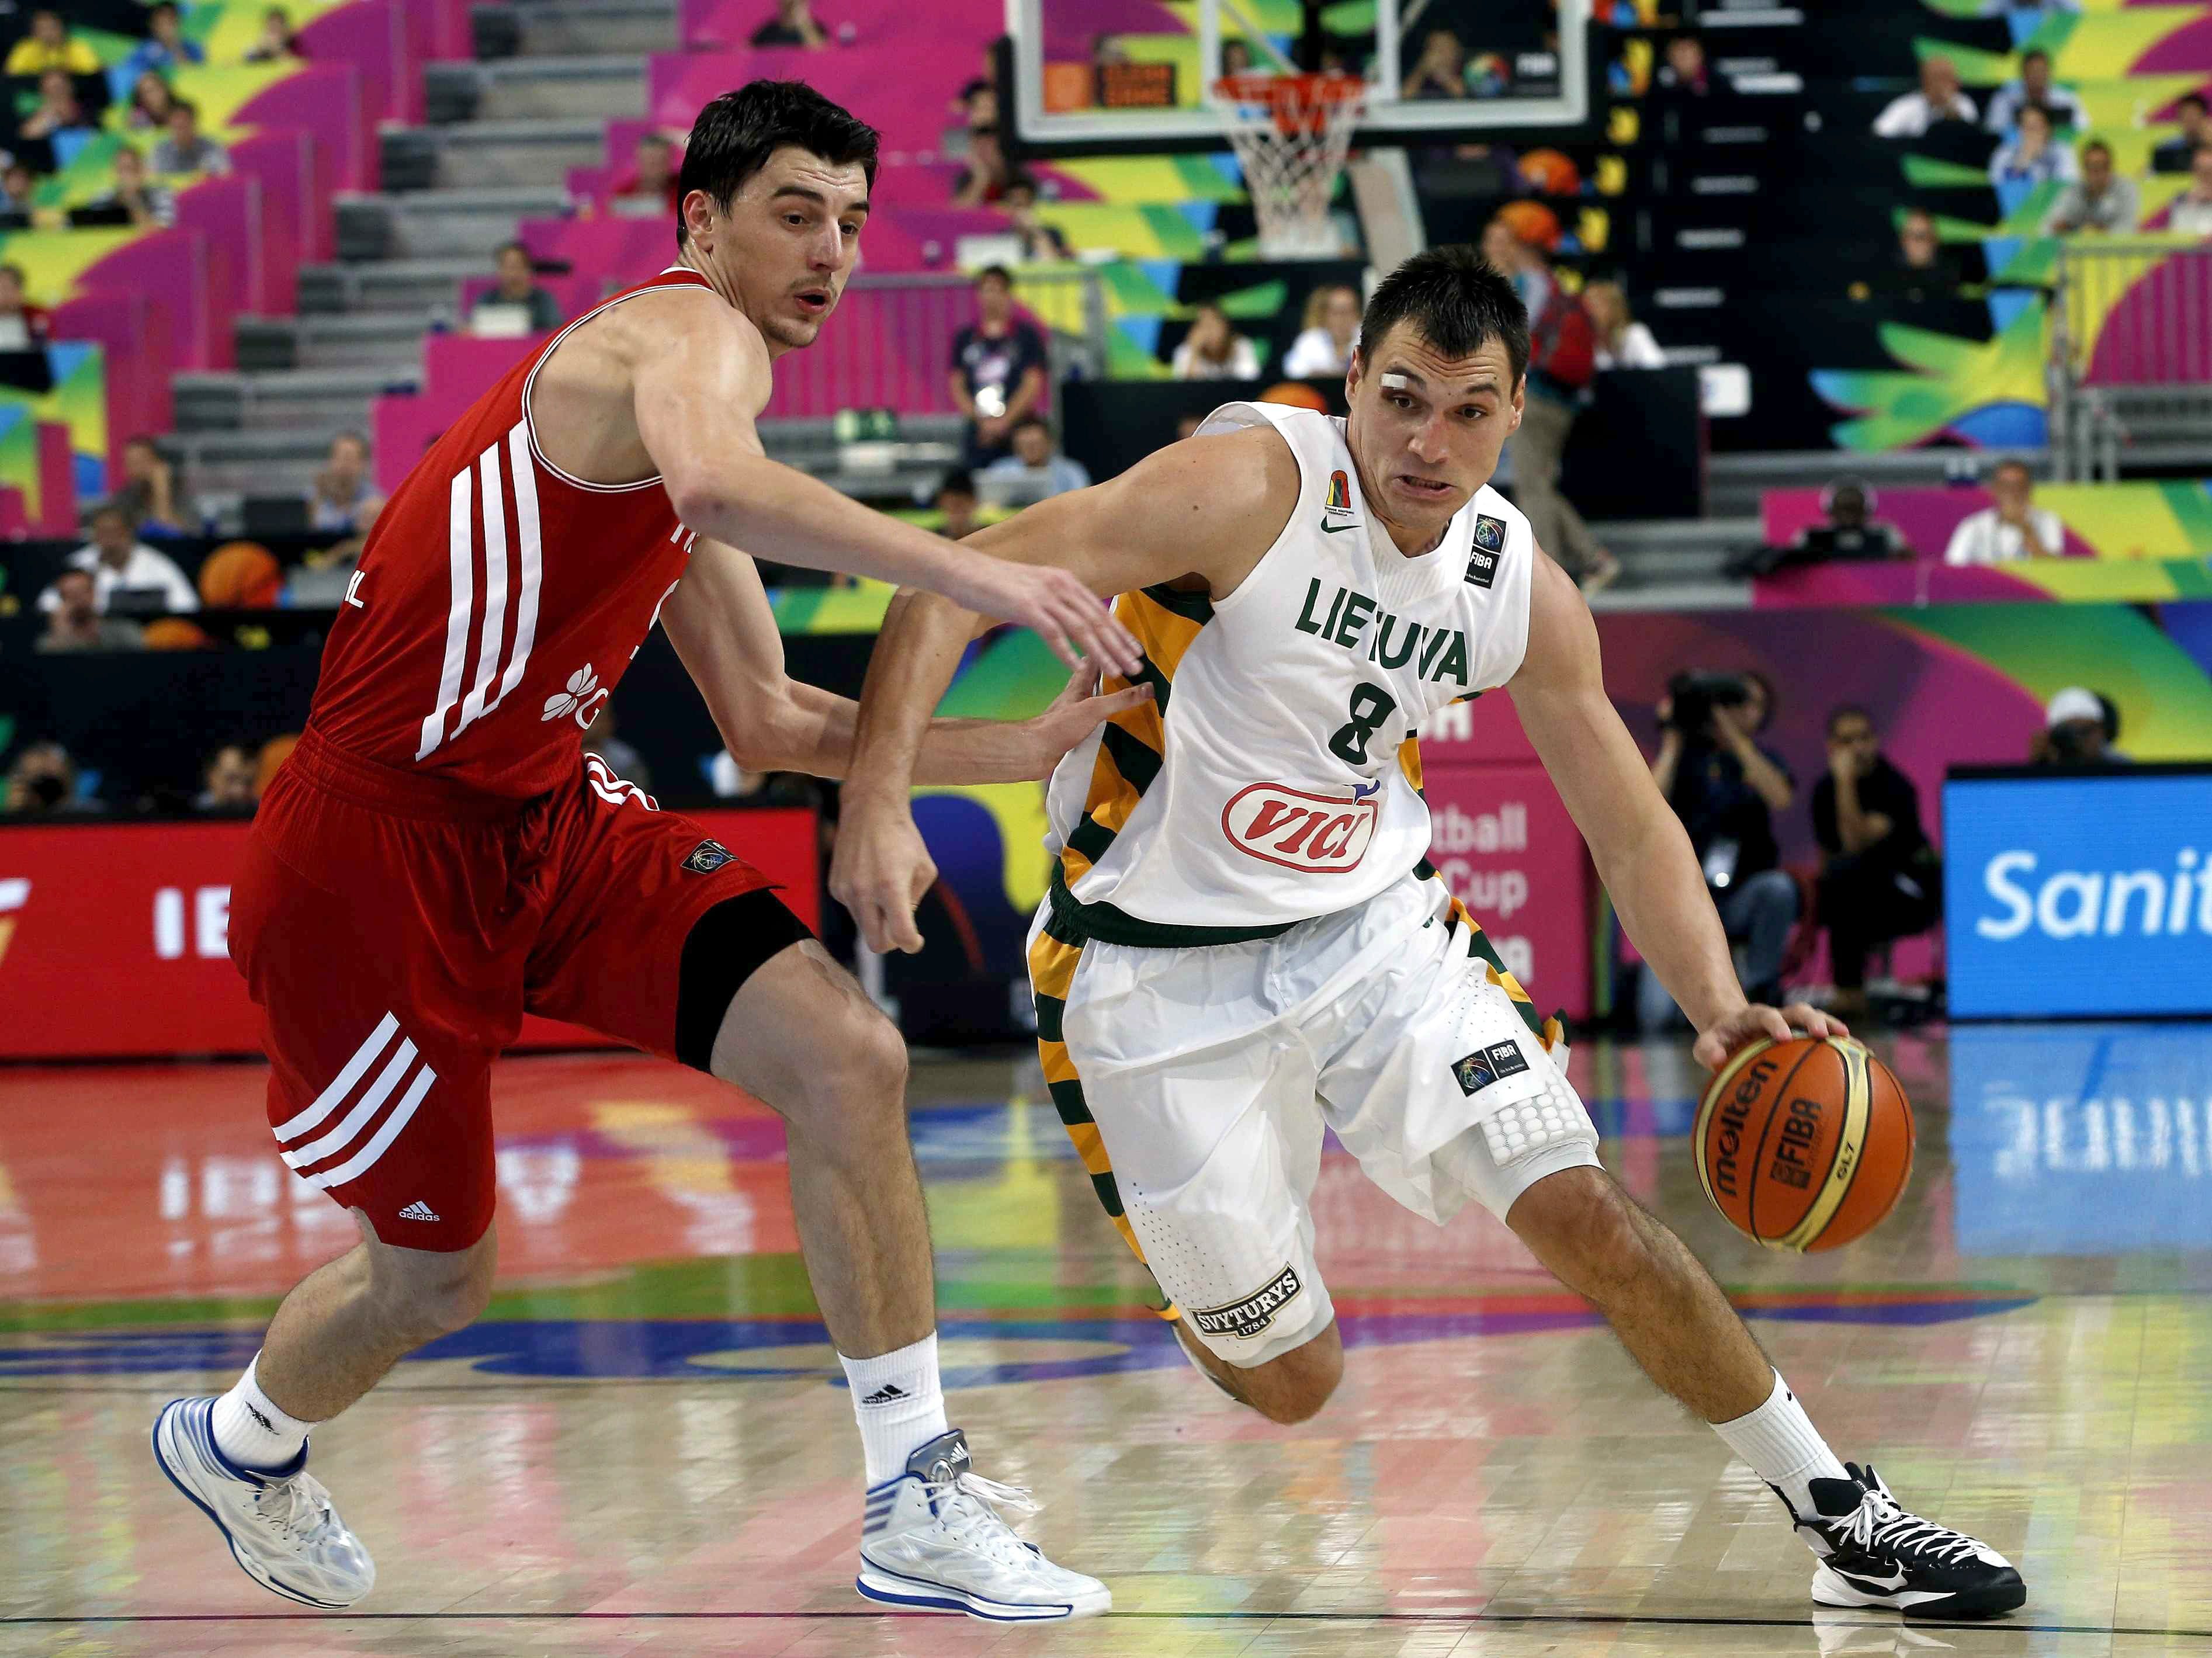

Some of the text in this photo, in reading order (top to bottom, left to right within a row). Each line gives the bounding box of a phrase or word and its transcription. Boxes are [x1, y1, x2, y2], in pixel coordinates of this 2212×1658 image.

[1469, 551, 1493, 570] FIBA
[1328, 682, 1398, 765] 8
[1244, 800, 1370, 860] VICI
[1442, 859, 1528, 919] Cup
[1491, 1044, 1517, 1061] FIBA
[1716, 1059, 1778, 1196] molten
[1776, 1098, 1823, 1167] FIBA
[399, 1210, 440, 1222] adidas
[1240, 1318, 1268, 1335] 1784
